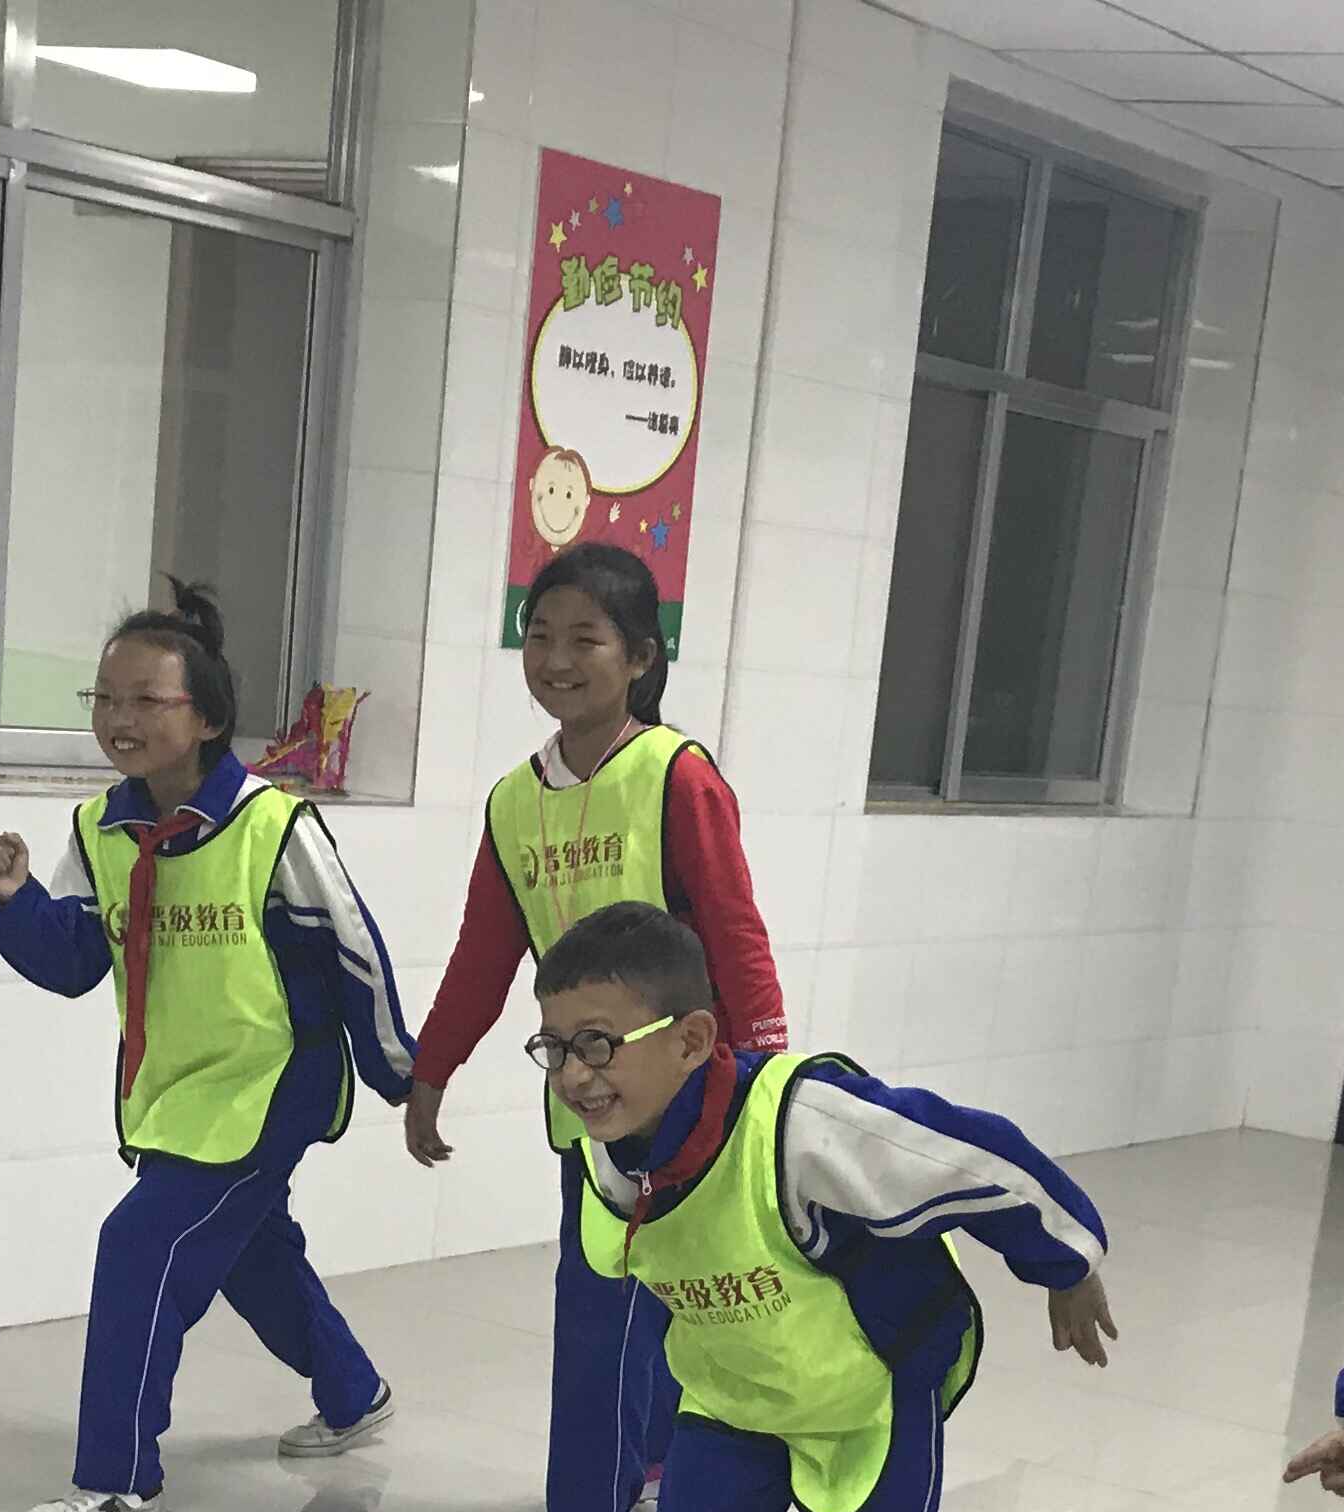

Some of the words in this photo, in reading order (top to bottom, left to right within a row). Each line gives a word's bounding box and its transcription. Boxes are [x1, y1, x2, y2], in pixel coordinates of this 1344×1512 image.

[560, 255, 682, 331] 勤俭节约
[182, 932, 247, 947] EDUCATION
[707, 1291, 792, 1326] EDUCATION
